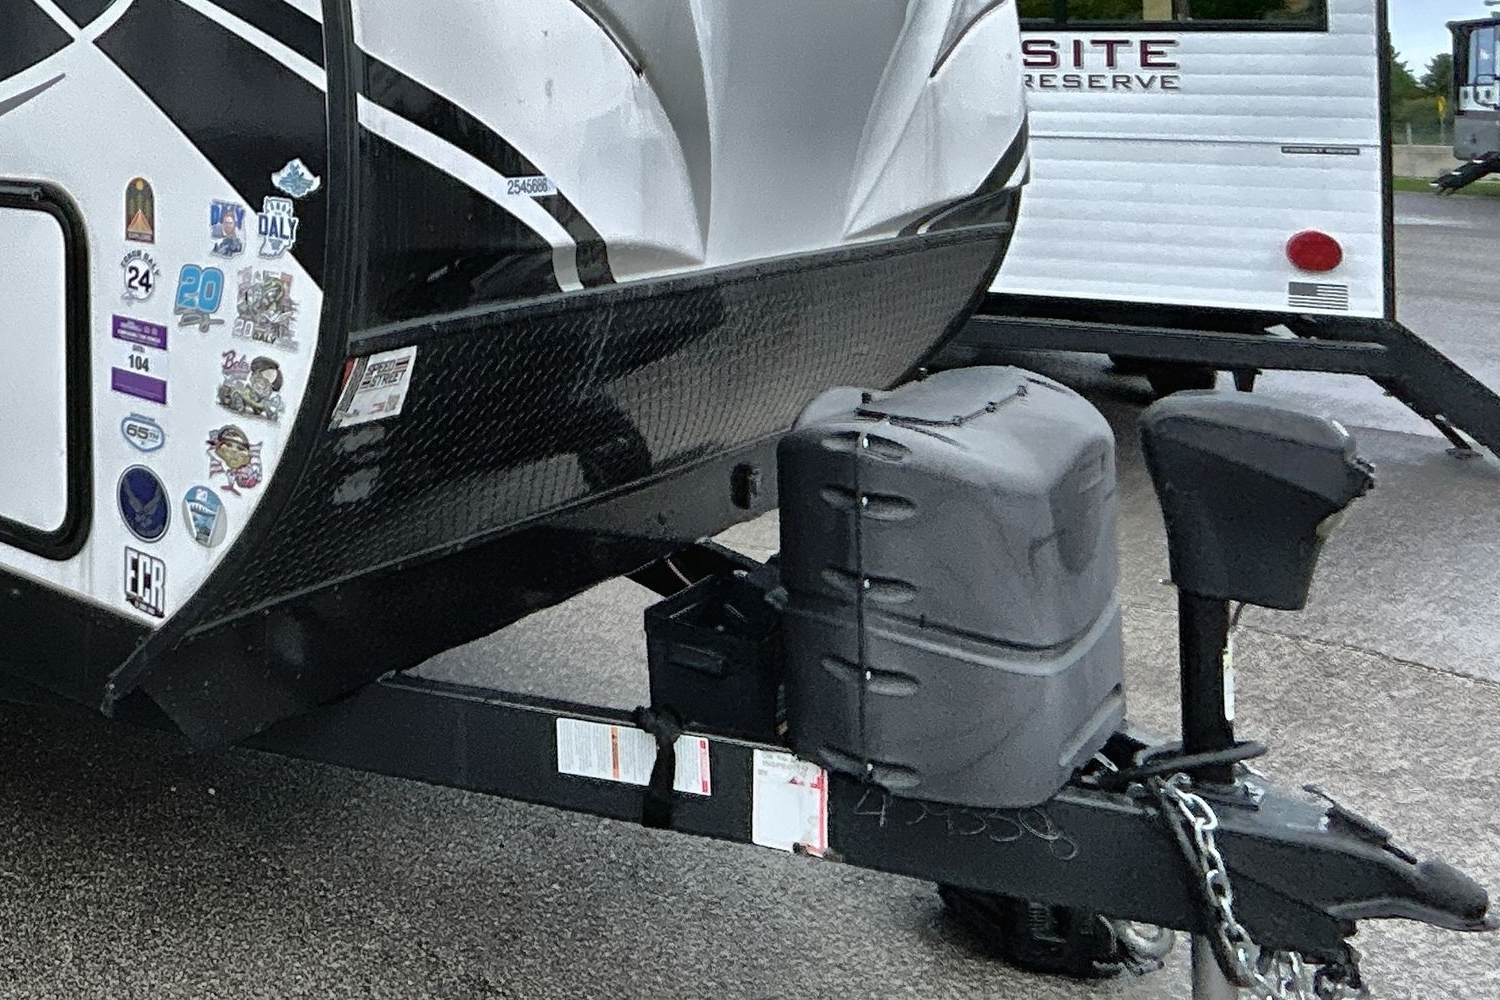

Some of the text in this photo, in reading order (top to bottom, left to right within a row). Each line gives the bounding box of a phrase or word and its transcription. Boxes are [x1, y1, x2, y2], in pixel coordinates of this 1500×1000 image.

[258, 215, 297, 240] DALY
[128, 266, 152, 292] 24
[176, 265, 223, 314] 20
[234, 318, 253, 338] 20
[128, 354, 150, 372] 104
[367, 360, 396, 375] SPEED
[369, 371, 406, 387] STREET
